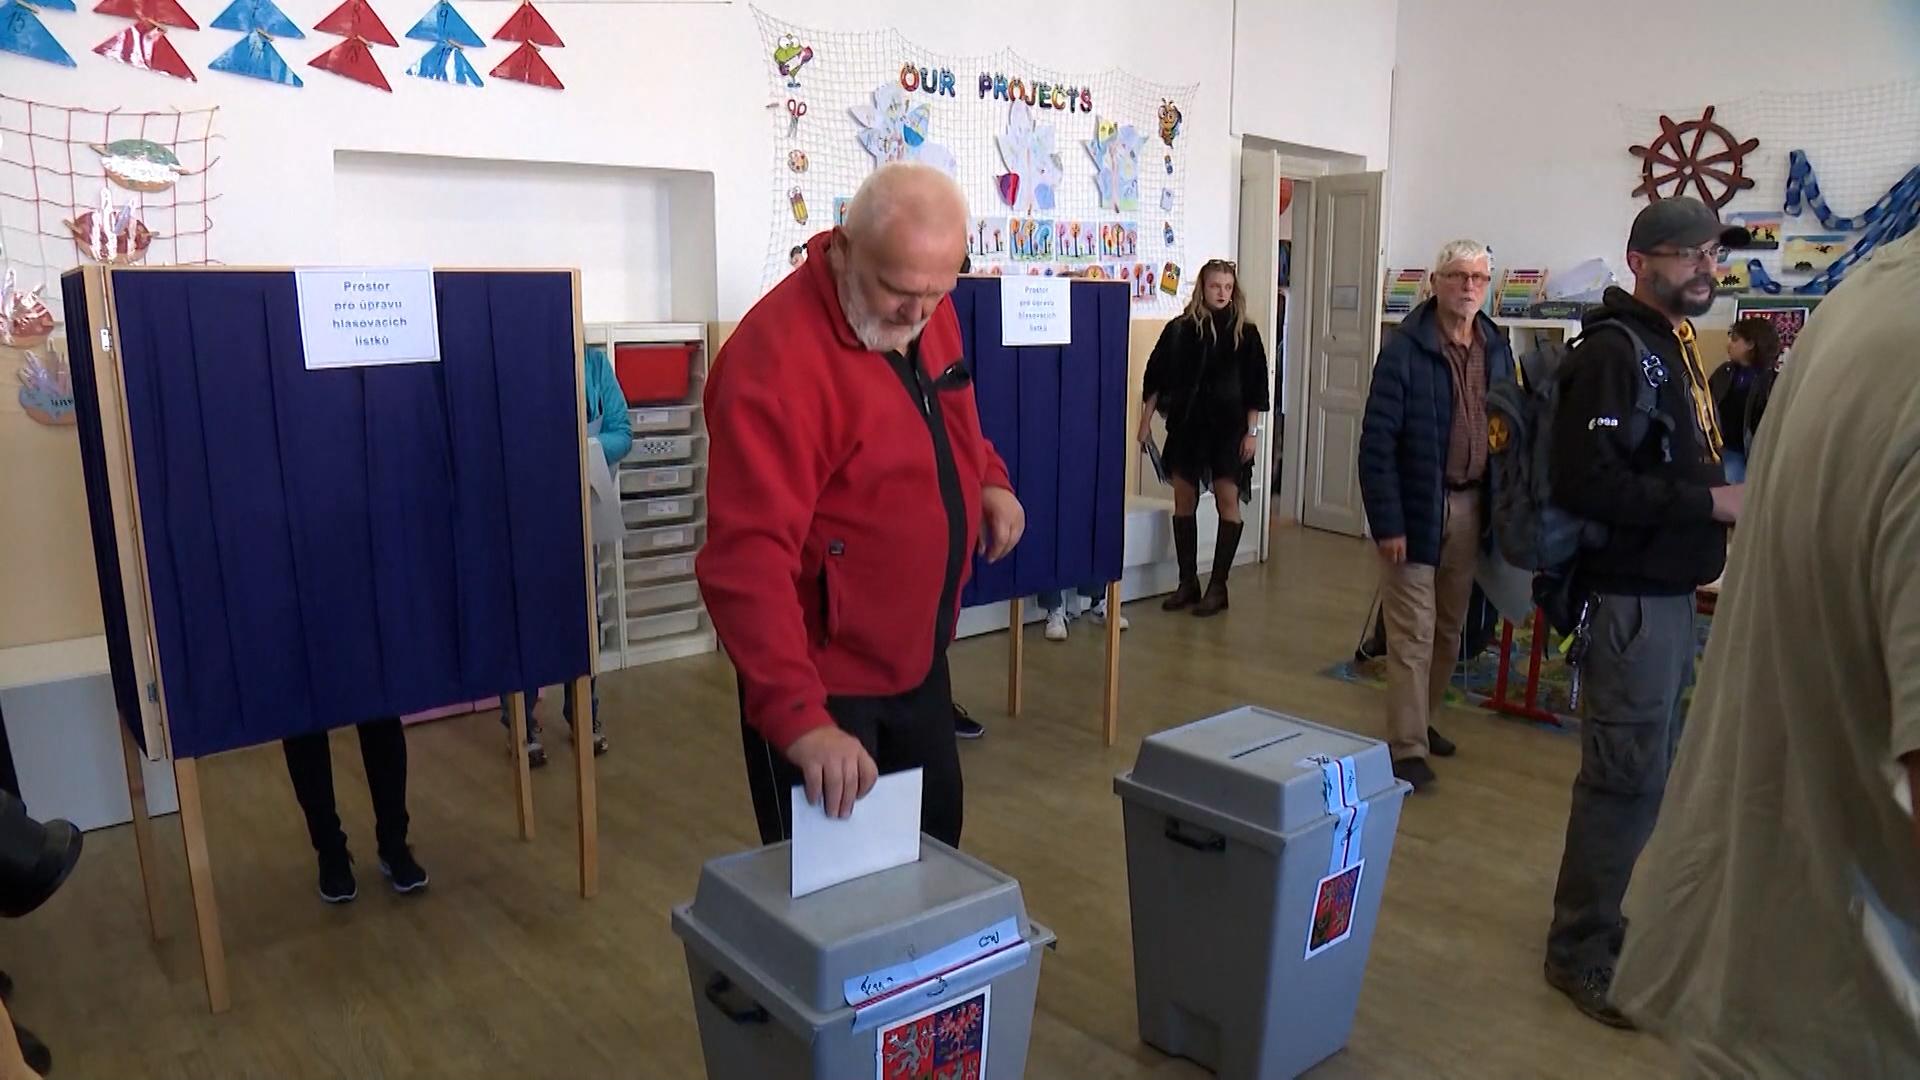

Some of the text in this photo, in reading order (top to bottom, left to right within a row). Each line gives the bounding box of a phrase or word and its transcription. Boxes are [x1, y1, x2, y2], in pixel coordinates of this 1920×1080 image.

[900, 61, 1092, 113] OUR PROJECTS
[343, 280, 391, 292] Prostor
[334, 299, 402, 312] pro úpravu
